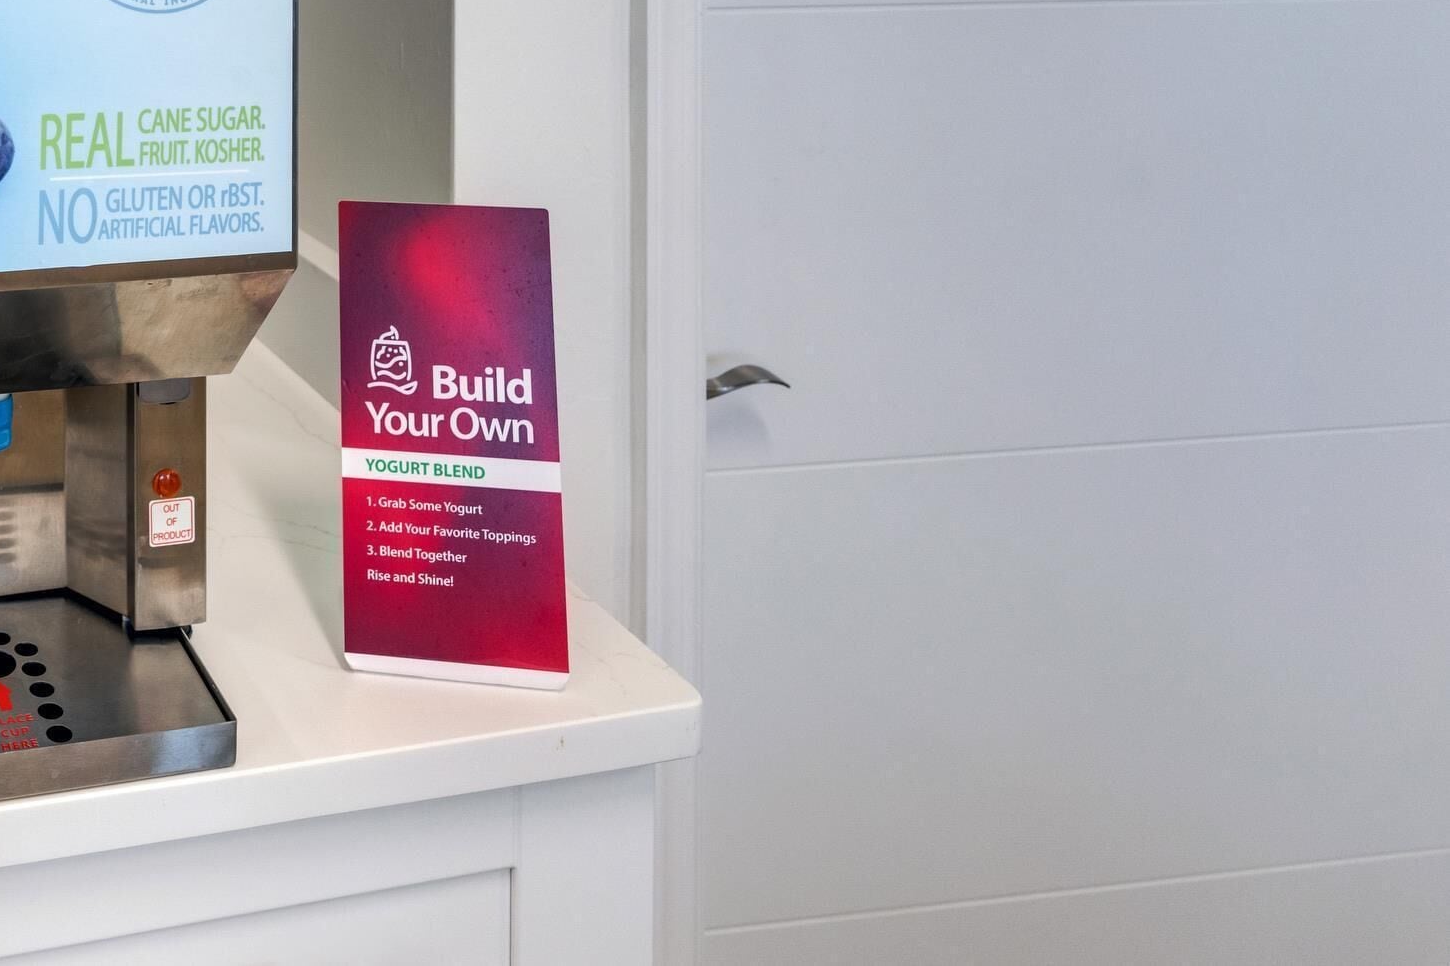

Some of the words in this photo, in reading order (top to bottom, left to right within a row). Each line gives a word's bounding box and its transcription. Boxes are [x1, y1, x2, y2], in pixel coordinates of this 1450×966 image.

[138, 108, 191, 134] CANE
[197, 105, 265, 132] SUGAR.
[40, 112, 135, 170] REAL
[140, 140, 190, 166] FRUIT.
[195, 137, 265, 164] KOSHER.
[105, 186, 183, 213] GLUTEN
[188, 184, 215, 209] OR
[221, 182, 265, 207] rBST.
[38, 187, 98, 245] NO
[98, 216, 185, 240] ARTIFICIAL
[190, 212, 264, 235] FLAVORS.
[432, 365, 533, 404] Build
[365, 401, 444, 438] Your
[450, 407, 535, 444] Own
[366, 459, 430, 475] YOGURT
[434, 464, 485, 479] BLEND
[163, 504, 179, 513] OUT
[367, 497, 376, 507] 1.
[378, 497, 406, 509] Grab
[409, 499, 441, 512] Some
[444, 502, 482, 516] Yogurt
[166, 517, 177, 526] OF
[153, 529, 191, 541] PRODUCT
[366, 521, 377, 531] 2.
[379, 521, 402, 533] Add
[405, 524, 430, 536] Your
[434, 526, 480, 539] Favorite
[482, 529, 536, 545] Toppings
[367, 545, 377, 556] 3.
[379, 546, 412, 559] Blend
[414, 548, 467, 563] Together
[367, 569, 391, 581] Rise
[393, 572, 415, 583] and
[417, 573, 454, 587] Shine!
[0, 727, 30, 738] CUP
[0, 738, 39, 752] HERE
